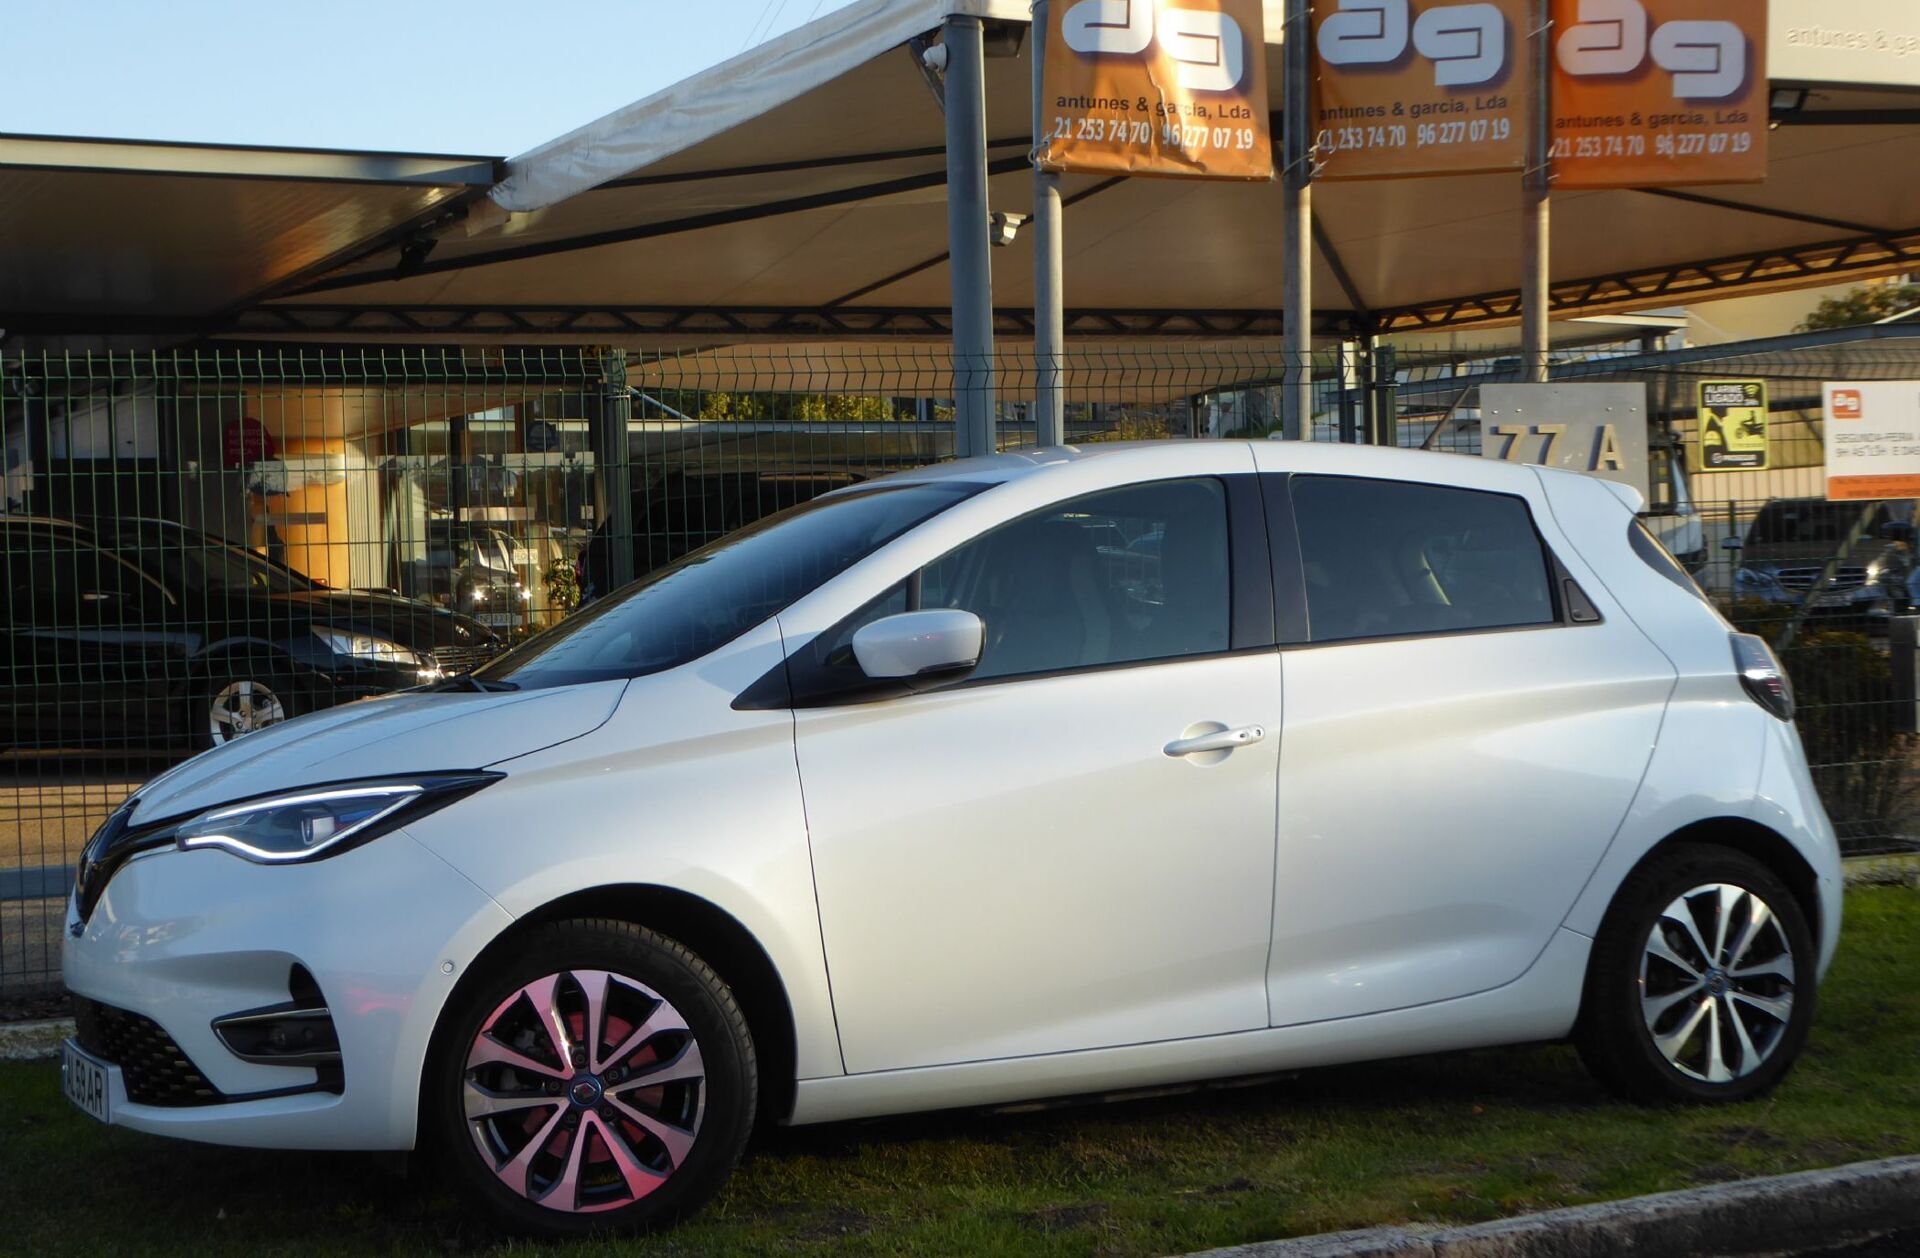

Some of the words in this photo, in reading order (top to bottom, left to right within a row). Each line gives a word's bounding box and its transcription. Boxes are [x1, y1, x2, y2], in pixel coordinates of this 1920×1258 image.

[1786, 27, 1869, 50] antunes
[1056, 95, 1129, 111] antunes
[1136, 98, 1149, 113] &
[1218, 104, 1250, 119] Lda
[1319, 104, 1386, 120] antunes
[1391, 102, 1404, 116] &
[1410, 99, 1469, 118] garcia,
[1476, 96, 1508, 111] Lda
[1556, 113, 1624, 129] antunes
[1630, 112, 1642, 126] &
[1649, 111, 1708, 129] garcia,
[1716, 110, 1749, 125] Lda
[1054, 117, 1072, 139] 21
[1077, 118, 1104, 141] 253
[1108, 119, 1127, 143] 74
[1130, 121, 1149, 144] 70
[1162, 124, 1180, 146] 96
[1183, 125, 1208, 149] 277
[1213, 127, 1231, 149] 07
[1235, 128, 1253, 150] 19
[1338, 127, 1363, 150] 253
[1368, 127, 1385, 148] 74
[1388, 125, 1406, 147] 70
[1417, 123, 1436, 147] 96
[1439, 121, 1465, 144] 277
[1469, 119, 1488, 142] 07
[1492, 118, 1510, 140] 19
[1554, 138, 1571, 158] 21
[1575, 136, 1601, 157] 253
[1605, 135, 1623, 156] 74
[1626, 135, 1645, 155] 70
[1655, 134, 1674, 155] 96
[1678, 133, 1705, 154] 277
[1708, 133, 1728, 153] 07
[1731, 132, 1750, 153] 19
[1491, 423, 1568, 465] 77
[1588, 423, 1625, 471] A
